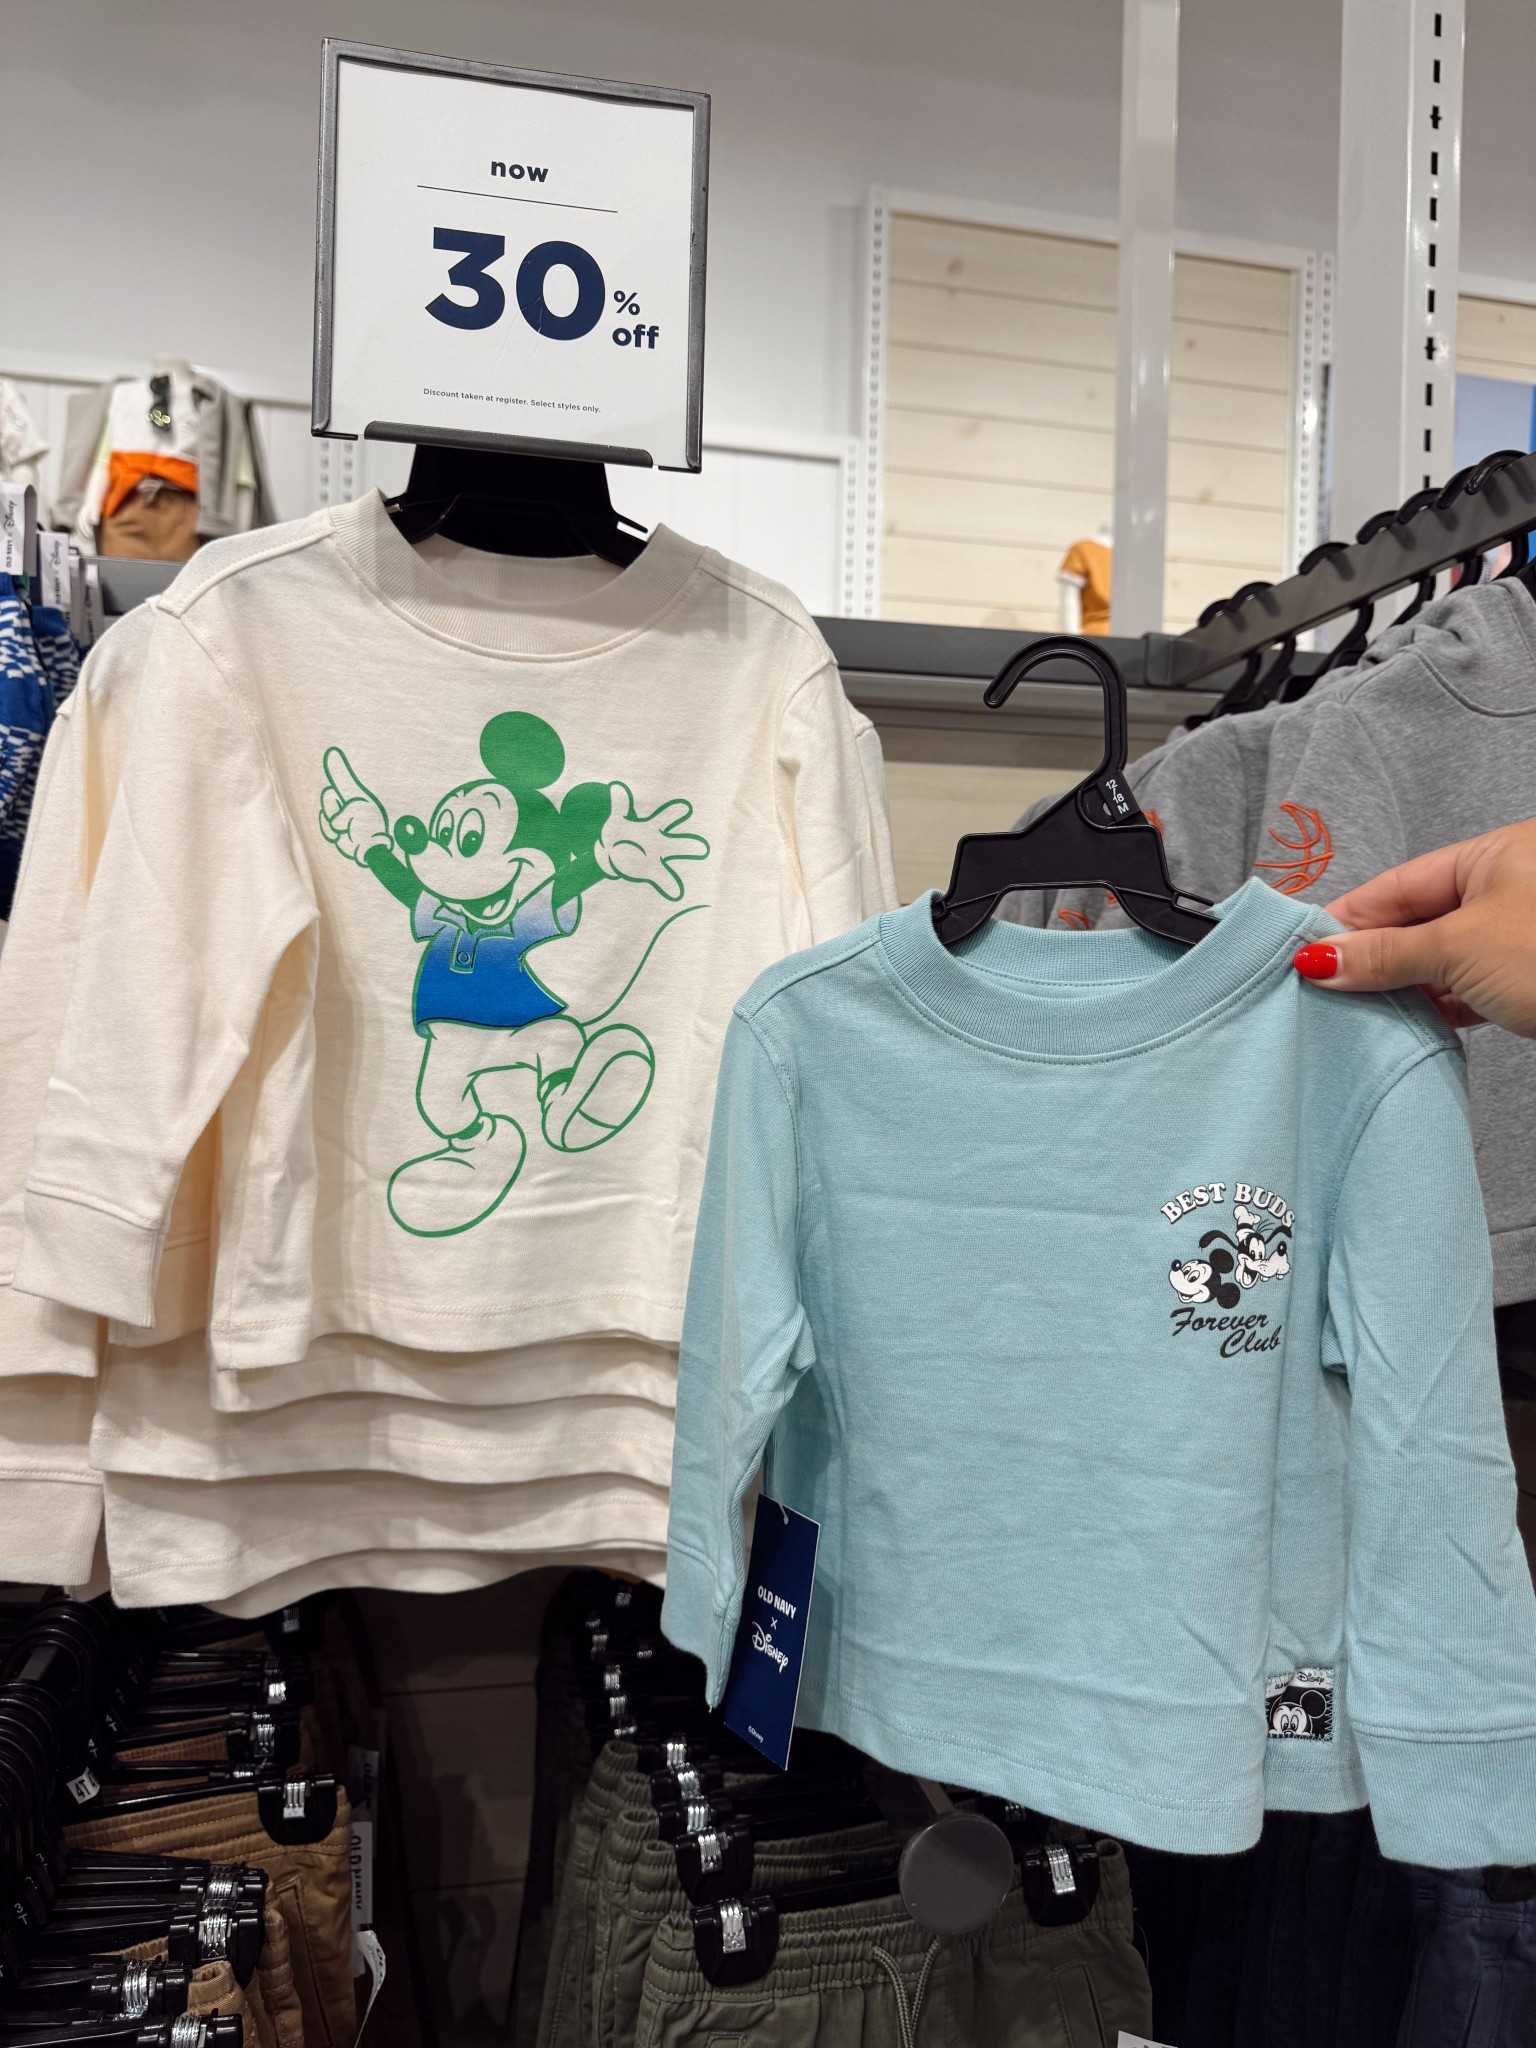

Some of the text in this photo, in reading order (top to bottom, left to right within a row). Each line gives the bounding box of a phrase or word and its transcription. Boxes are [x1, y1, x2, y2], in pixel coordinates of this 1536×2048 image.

[490, 159, 549, 183] now
[424, 226, 606, 341] 30
[612, 324, 660, 349] off
[423, 388, 459, 399] Discount
[461, 392, 484, 401] taken
[495, 396, 529, 406] register.
[530, 399, 556, 409] Select
[557, 402, 581, 411] styles
[582, 405, 601, 413] only.
[1116, 802, 1129, 814] M
[1160, 1182, 1296, 1229] BEST BUDS
[1170, 1307, 1269, 1337] Forever
[1219, 1325, 1283, 1359] Club
[757, 1585, 797, 1619] OLD NAVY
